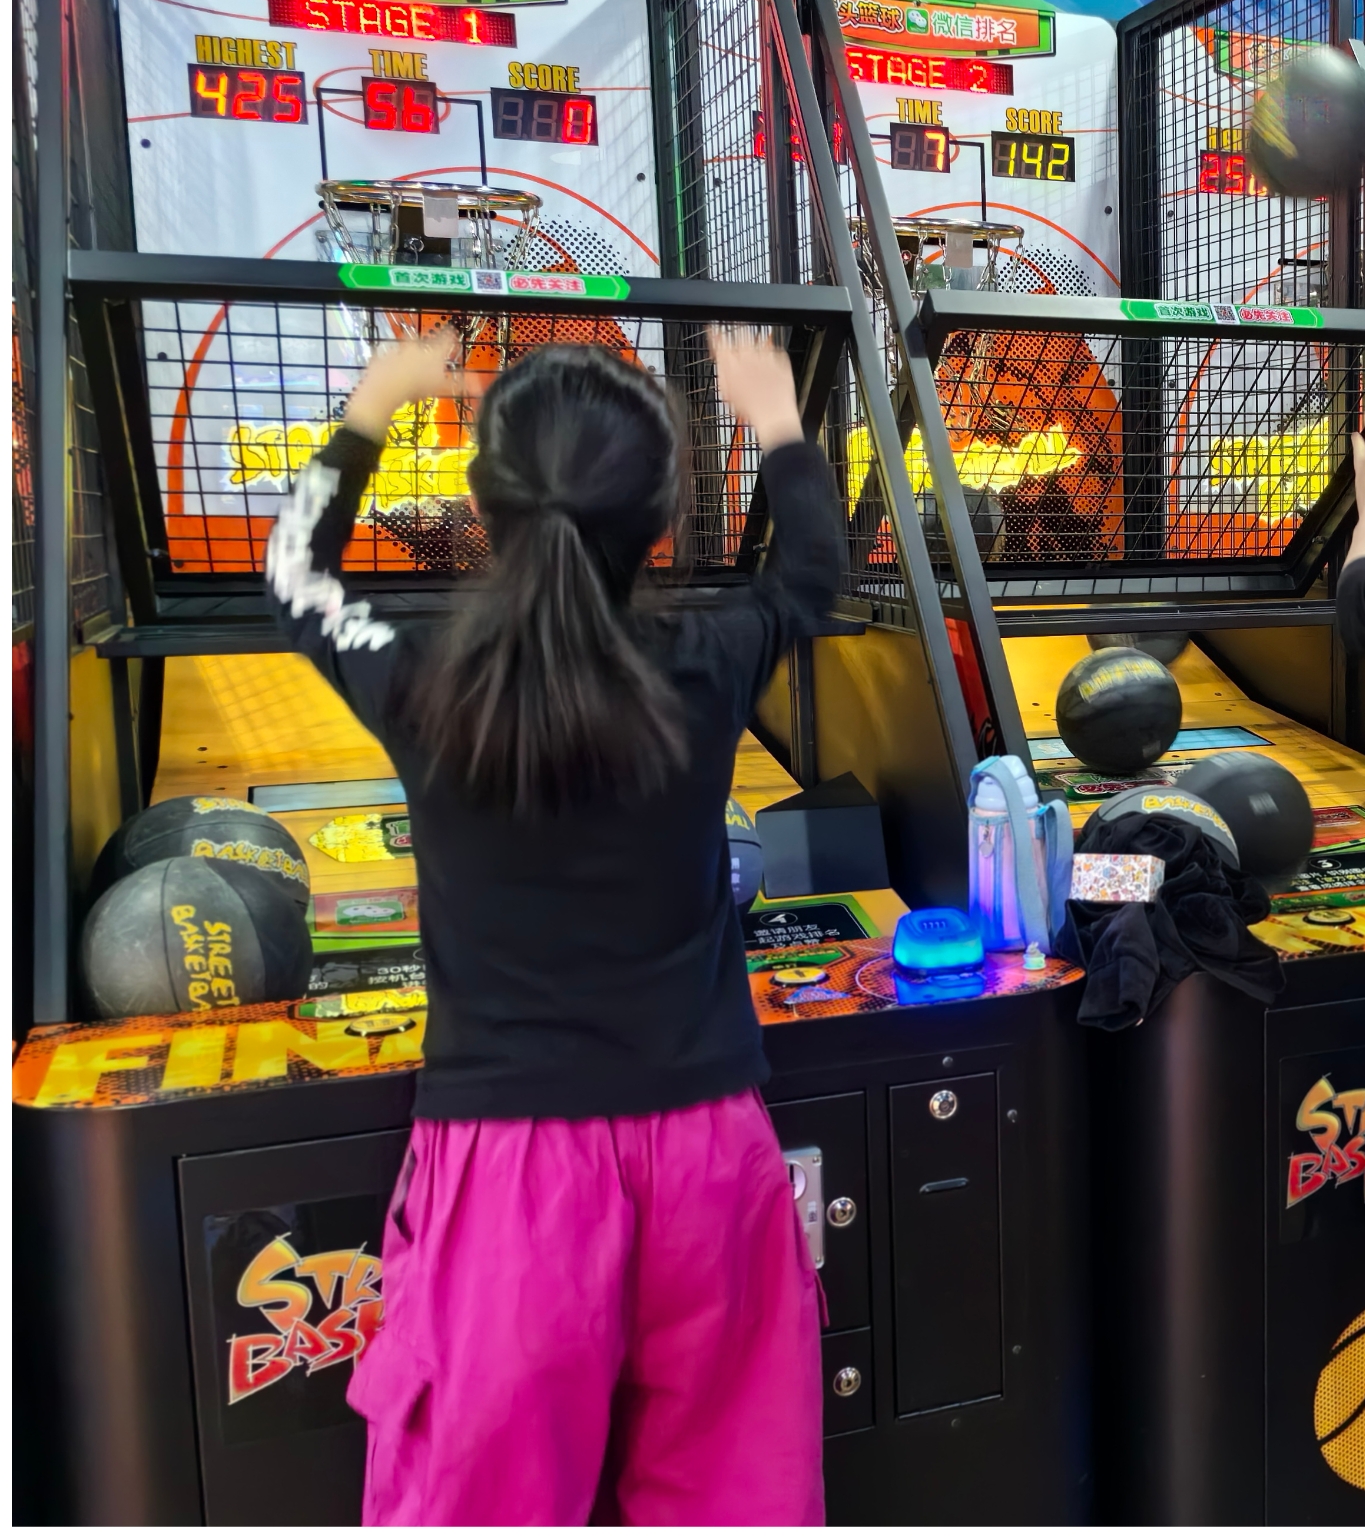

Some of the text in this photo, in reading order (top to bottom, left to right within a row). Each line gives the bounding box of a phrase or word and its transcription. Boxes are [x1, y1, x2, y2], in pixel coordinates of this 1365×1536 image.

[463, 8, 483, 44] 1
[931, 12, 1018, 45] 微信排名
[195, 34, 297, 70] HIGHEST
[368, 48, 429, 81] TIME
[508, 61, 580, 93] SCORE
[969, 64, 988, 94] 2
[195, 69, 302, 124] 425
[366, 80, 434, 134] 56
[896, 97, 943, 126] TIME
[1005, 107, 1063, 134] SCORE
[1006, 142, 1071, 181] 142
[392, 270, 584, 293] 首次游戏 必先关注
[1157, 305, 1212, 318] 首次游戏
[203, 920, 241, 1006] STREET
[377, 965, 426, 976] 30秒
[34, 1019, 424, 1107] FIN
